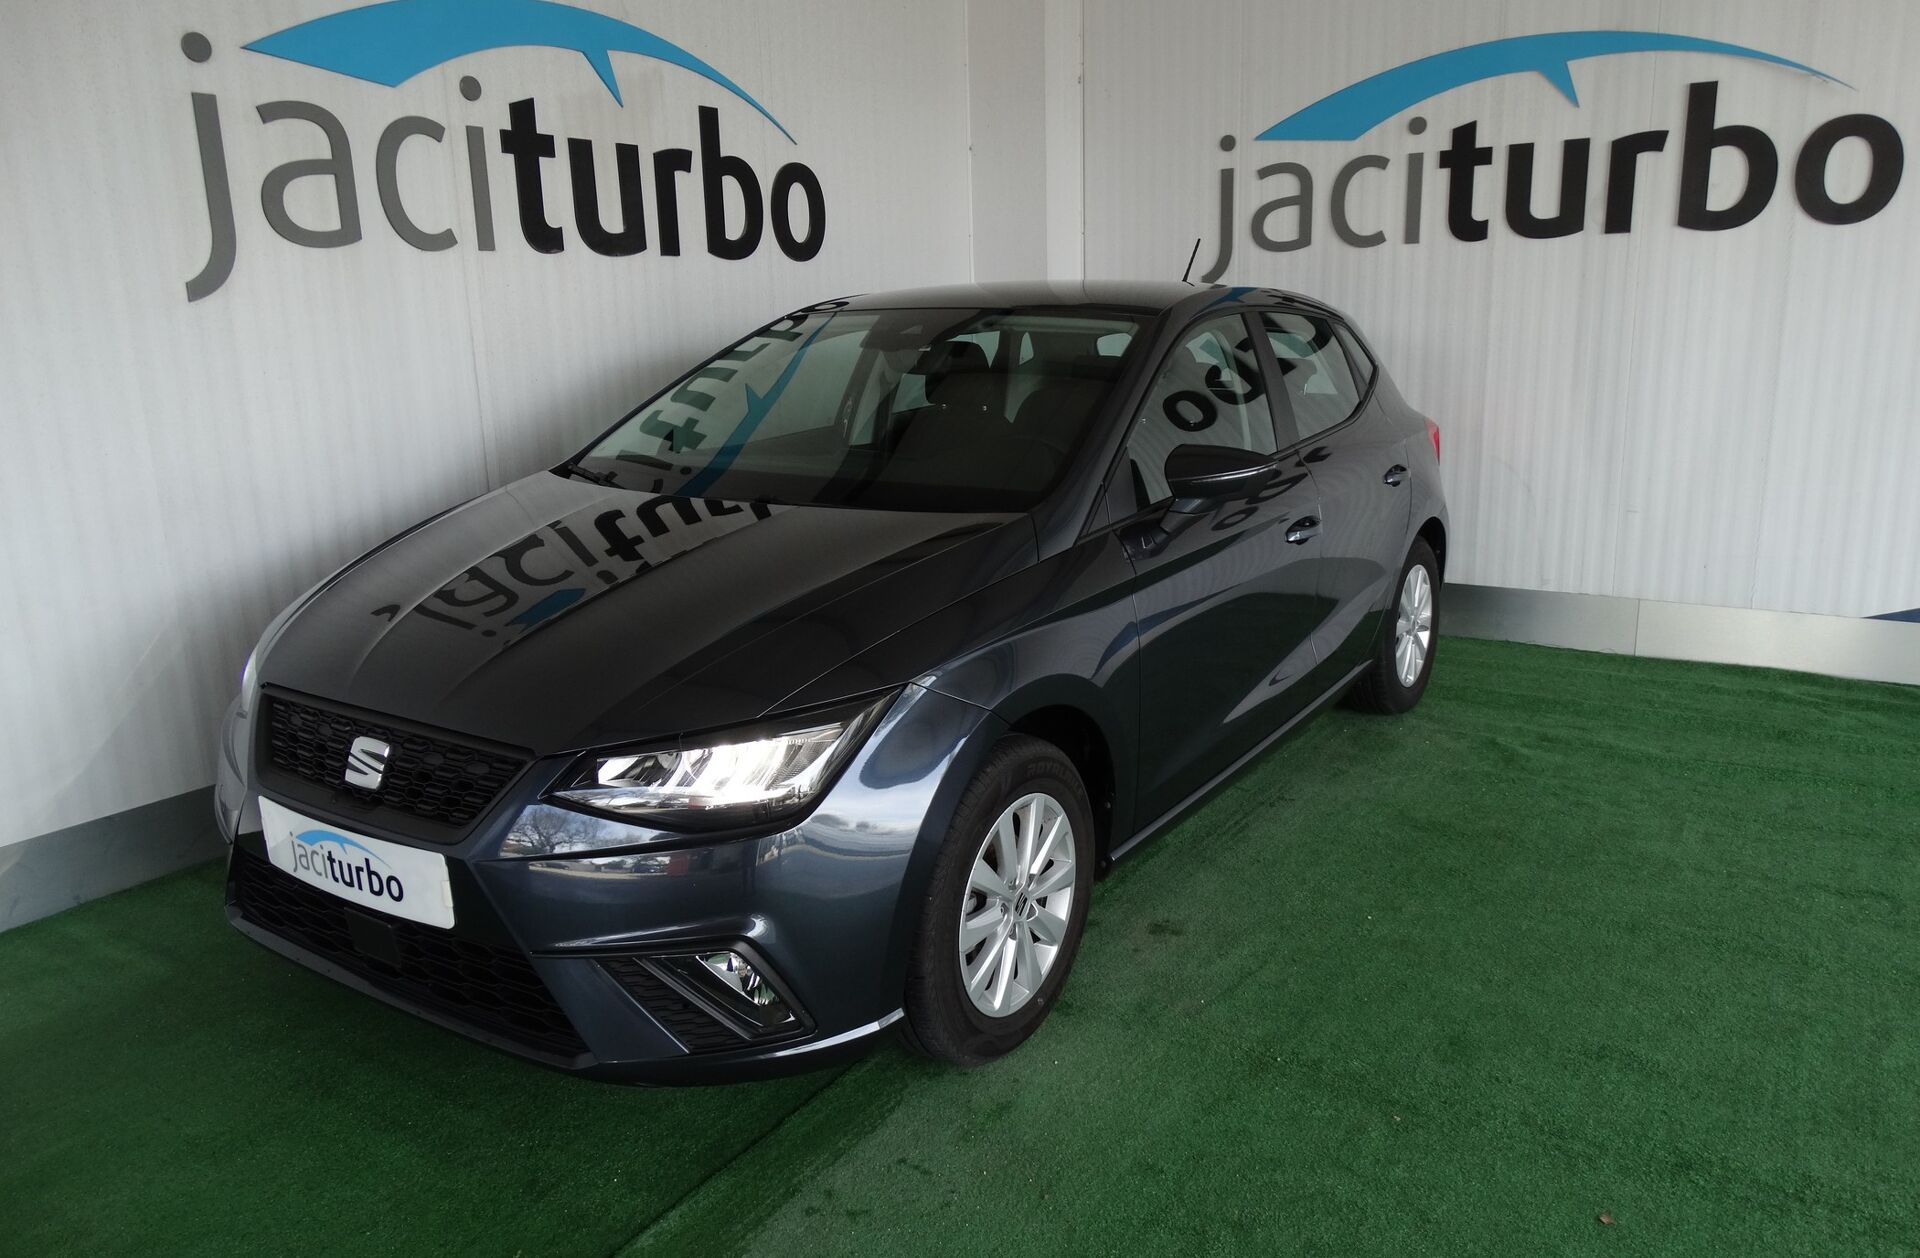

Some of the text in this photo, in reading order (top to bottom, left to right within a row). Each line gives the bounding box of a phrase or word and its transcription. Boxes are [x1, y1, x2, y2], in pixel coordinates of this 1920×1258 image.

[180, 31, 826, 303] jaciturbo
[1200, 80, 1905, 284] jaciturbo
[289, 831, 404, 903] jaciturbo
